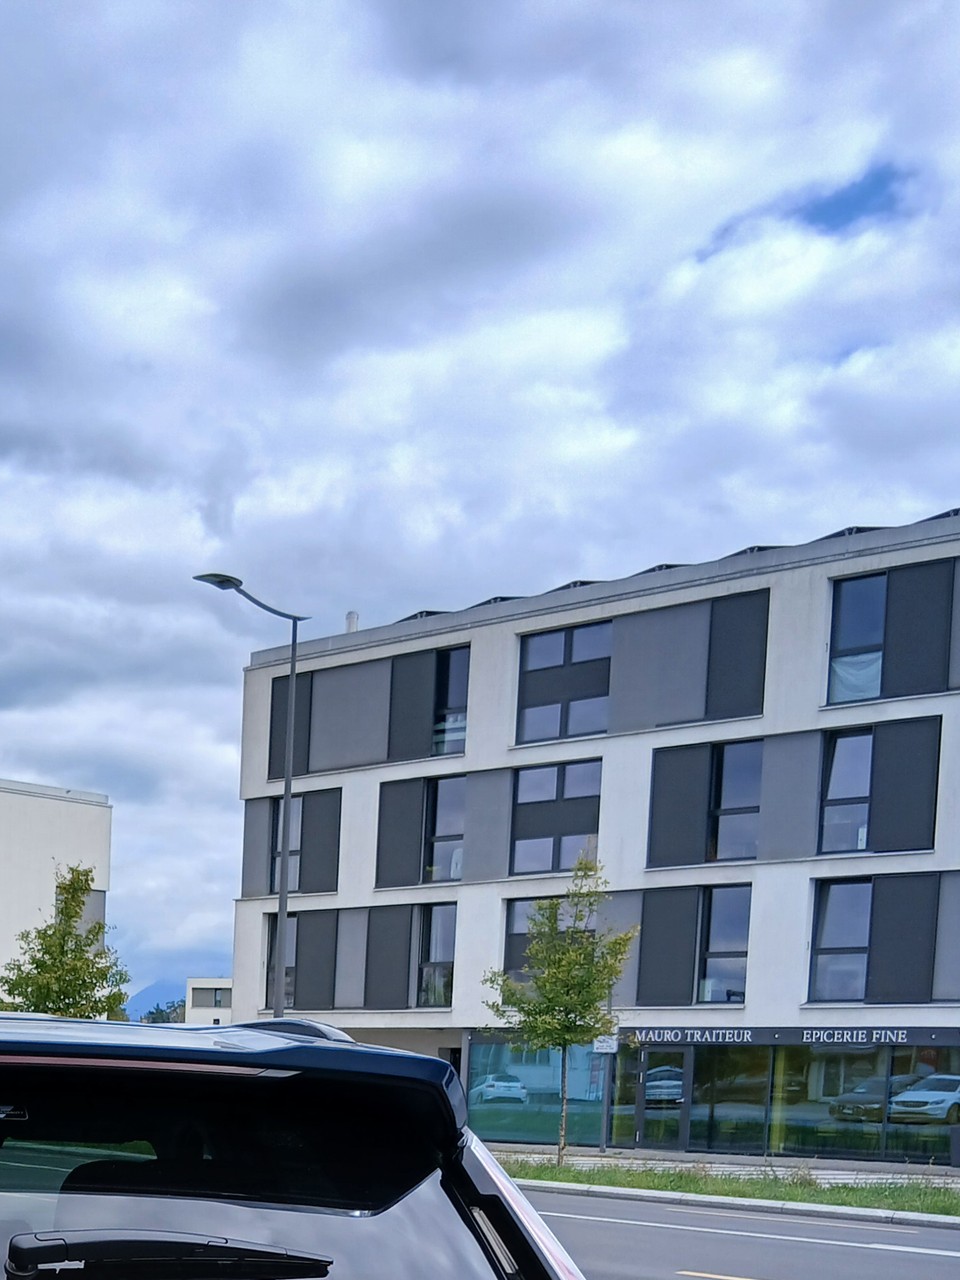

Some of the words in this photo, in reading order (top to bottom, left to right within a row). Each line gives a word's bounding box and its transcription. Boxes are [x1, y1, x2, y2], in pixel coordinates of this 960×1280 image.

[634, 1029, 681, 1042] MAURO
[685, 1029, 752, 1042] TRAITEUR
[802, 1030, 867, 1043] EPICERIE
[871, 1030, 908, 1043] FINE
